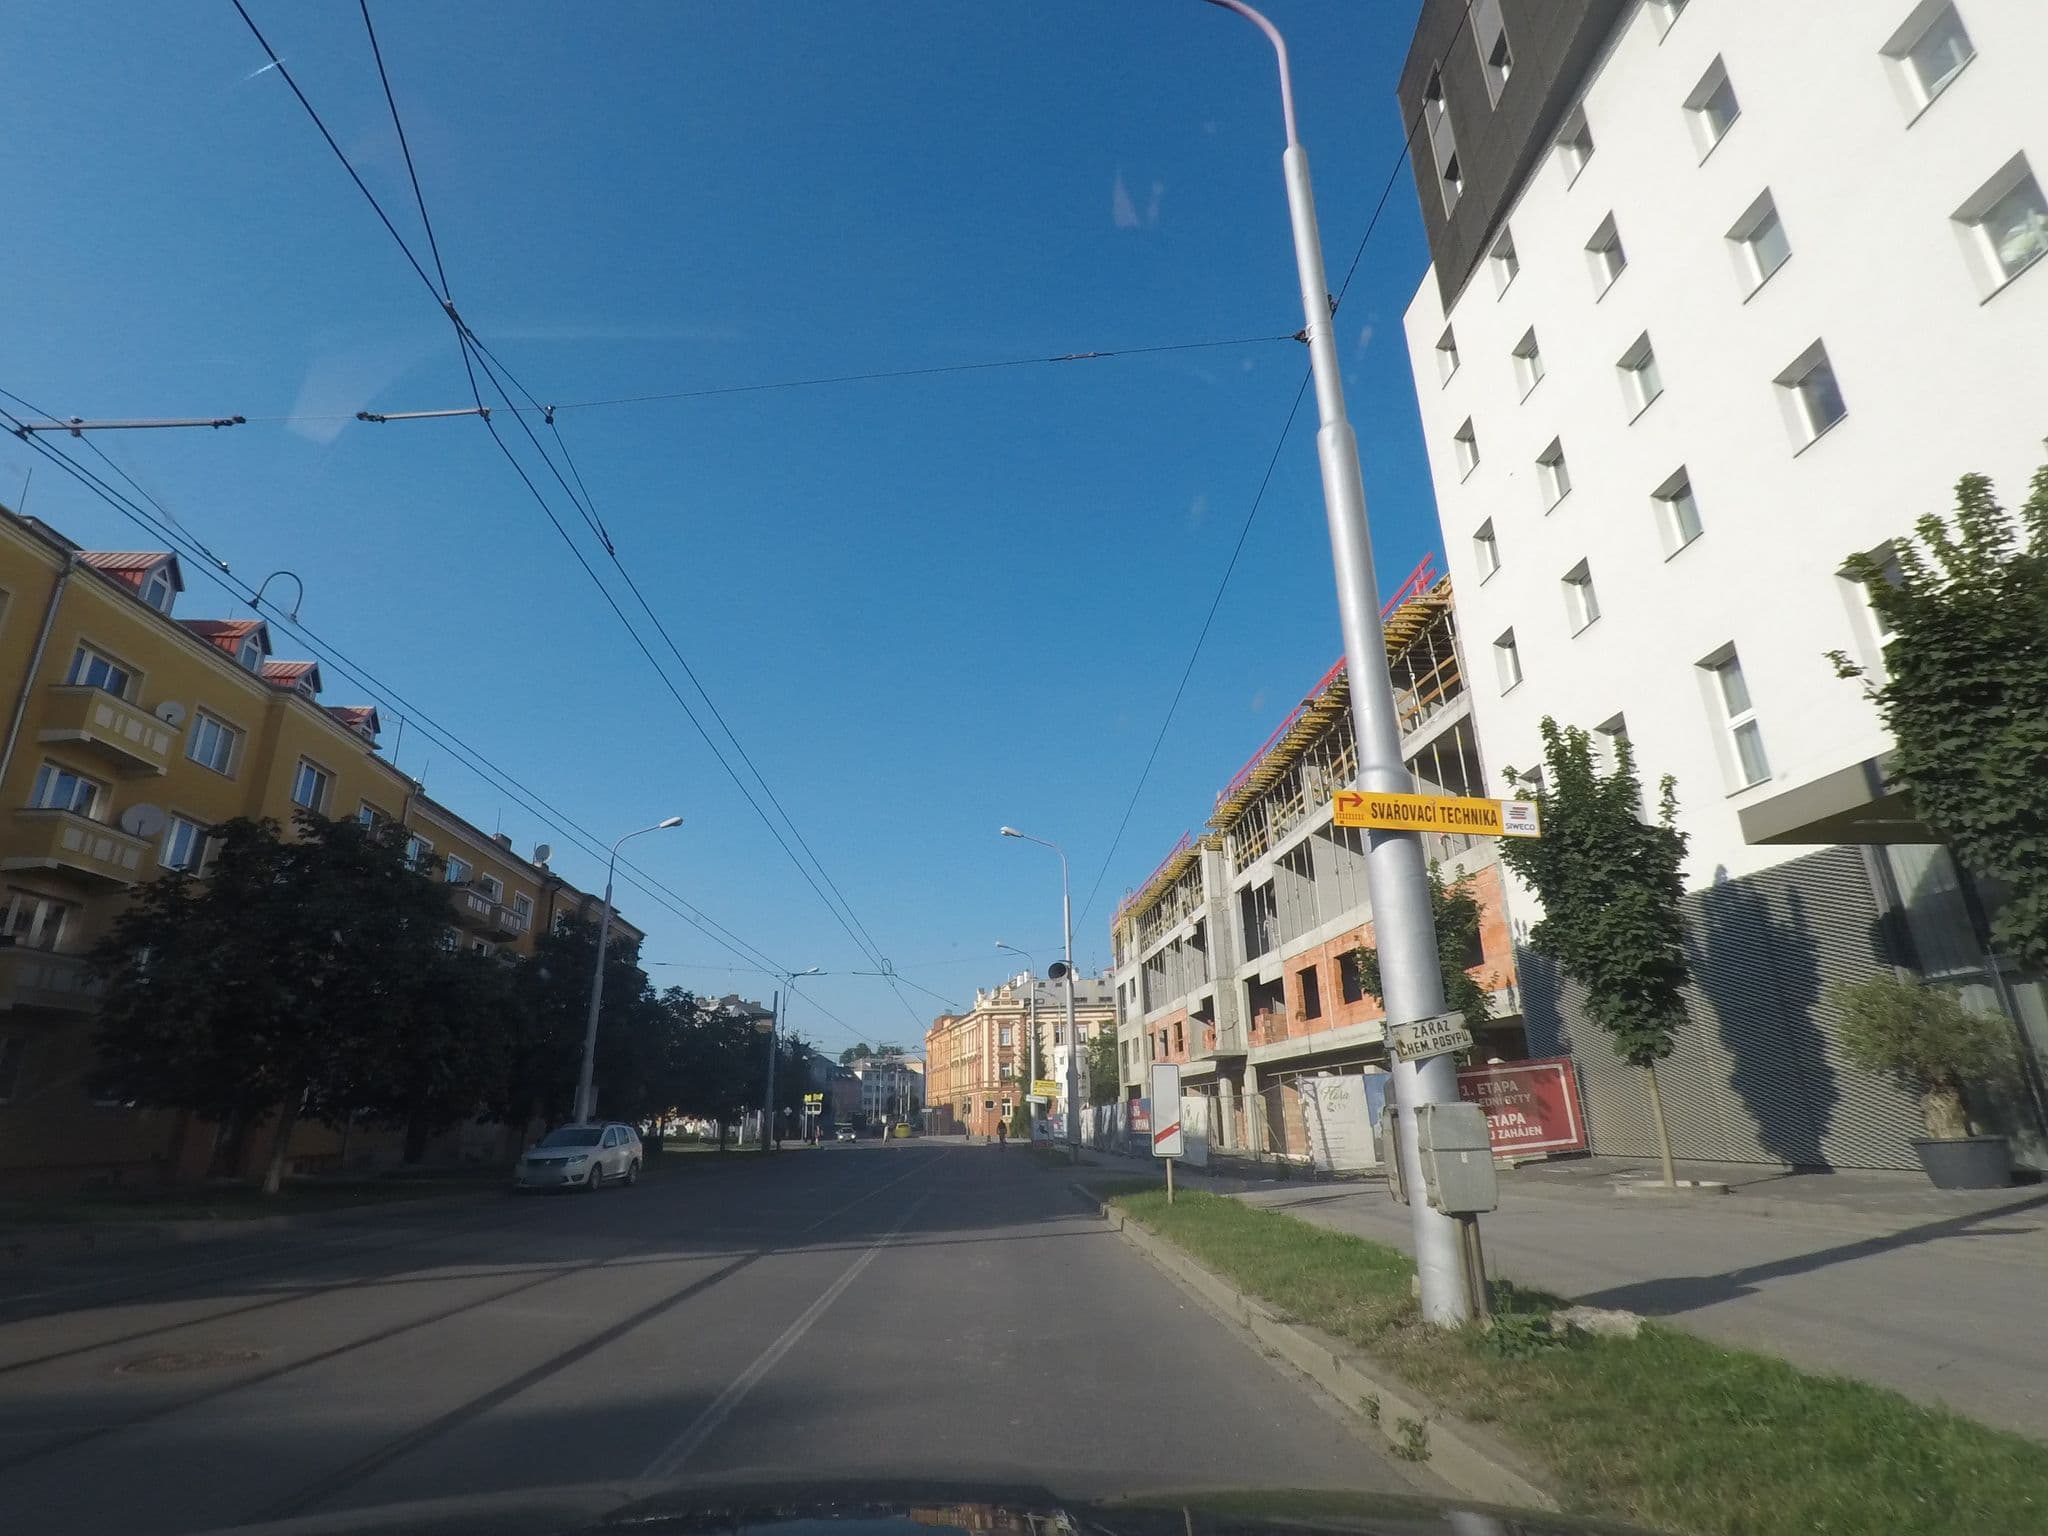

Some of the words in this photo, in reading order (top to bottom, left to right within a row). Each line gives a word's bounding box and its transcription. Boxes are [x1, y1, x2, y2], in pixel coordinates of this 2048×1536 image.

[1371, 799, 1437, 822] SVAŘOVACÍ
[1440, 806, 1498, 826] TECHNIKA
[1505, 822, 1536, 831] SIWECO
[1432, 1031, 1469, 1050] POSYPU
[1477, 1080, 1518, 1095] ETAPA
[1486, 1112, 1527, 1128] ETAPA
[1497, 1125, 1543, 1139] ZAHÁJEN
